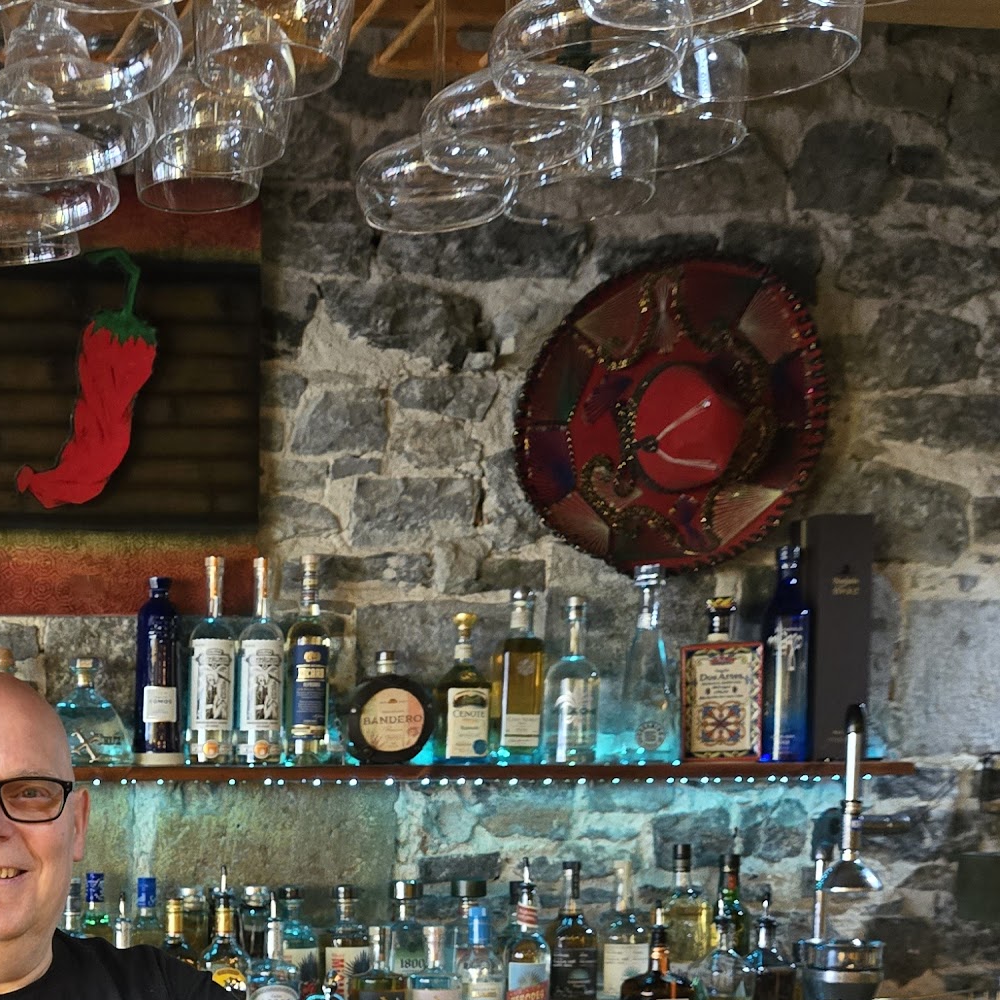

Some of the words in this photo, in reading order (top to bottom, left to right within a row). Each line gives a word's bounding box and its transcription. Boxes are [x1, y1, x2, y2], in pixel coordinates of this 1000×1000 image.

[452, 710, 486, 718] CENOTE
[363, 714, 423, 725] BANDERO
[400, 958, 425, 968] 1800
